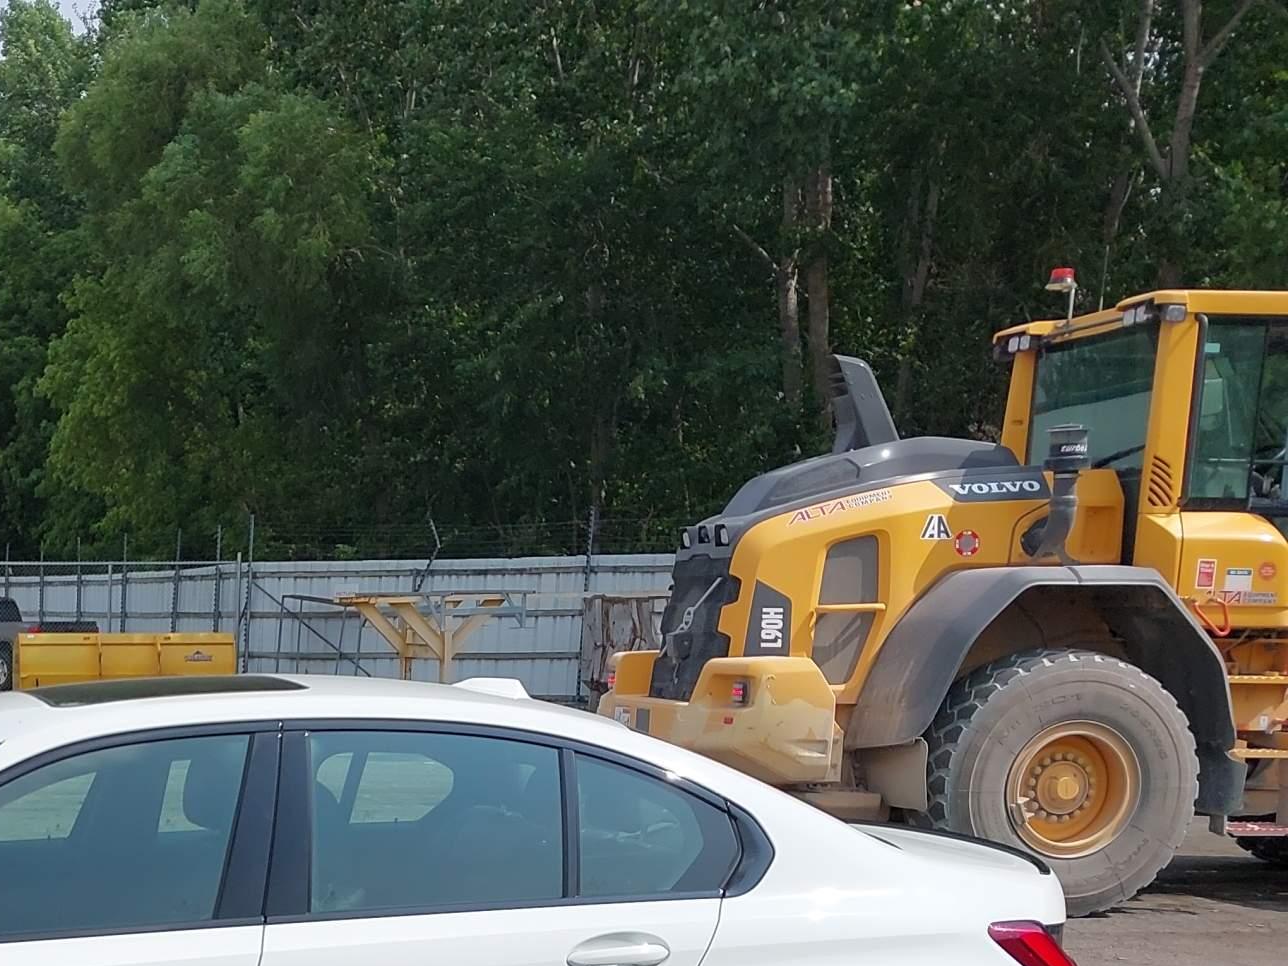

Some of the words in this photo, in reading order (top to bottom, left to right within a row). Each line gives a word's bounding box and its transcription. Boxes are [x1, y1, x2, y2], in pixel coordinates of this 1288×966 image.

[949, 480, 1041, 495] VOLVO
[788, 501, 847, 526] ALTA
[760, 607, 784, 648] L90H
